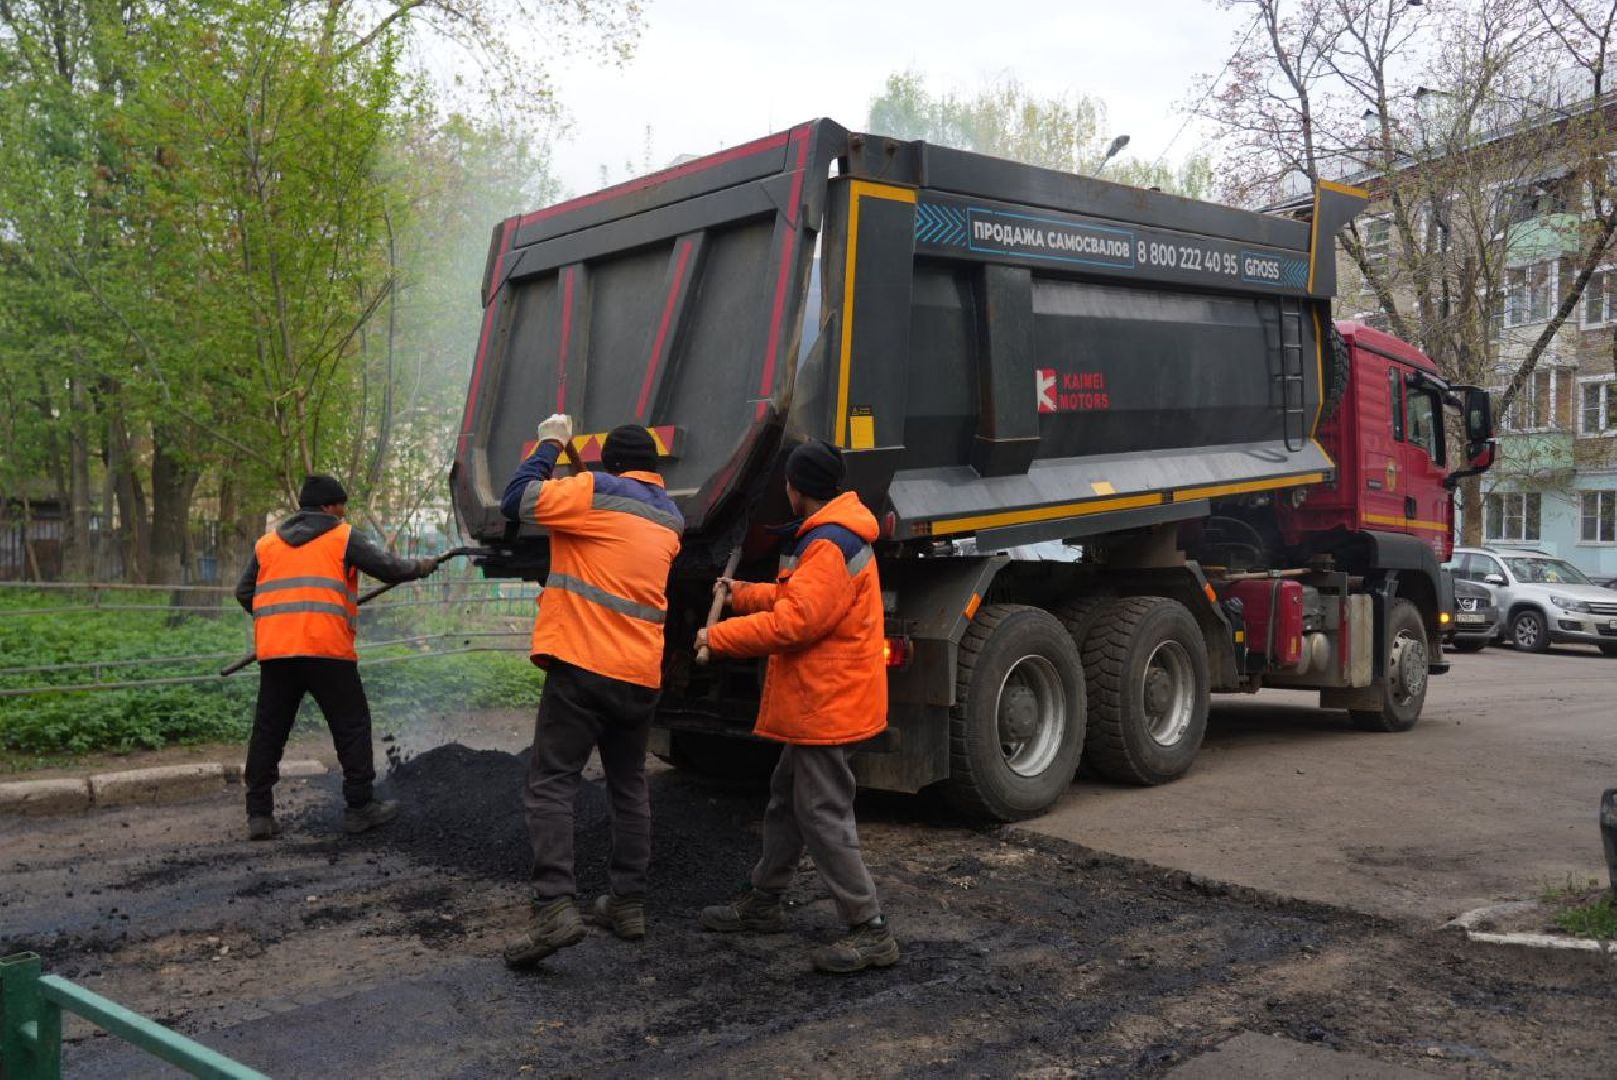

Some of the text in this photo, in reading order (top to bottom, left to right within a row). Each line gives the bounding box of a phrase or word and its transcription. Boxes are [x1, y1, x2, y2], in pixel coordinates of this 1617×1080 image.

[974, 221, 1130, 257] ПРОДАЖА САМОСВАЛОВ
[1137, 240, 1238, 275] 8 800 222 40 95
[1060, 393, 1111, 411] MOTORS
